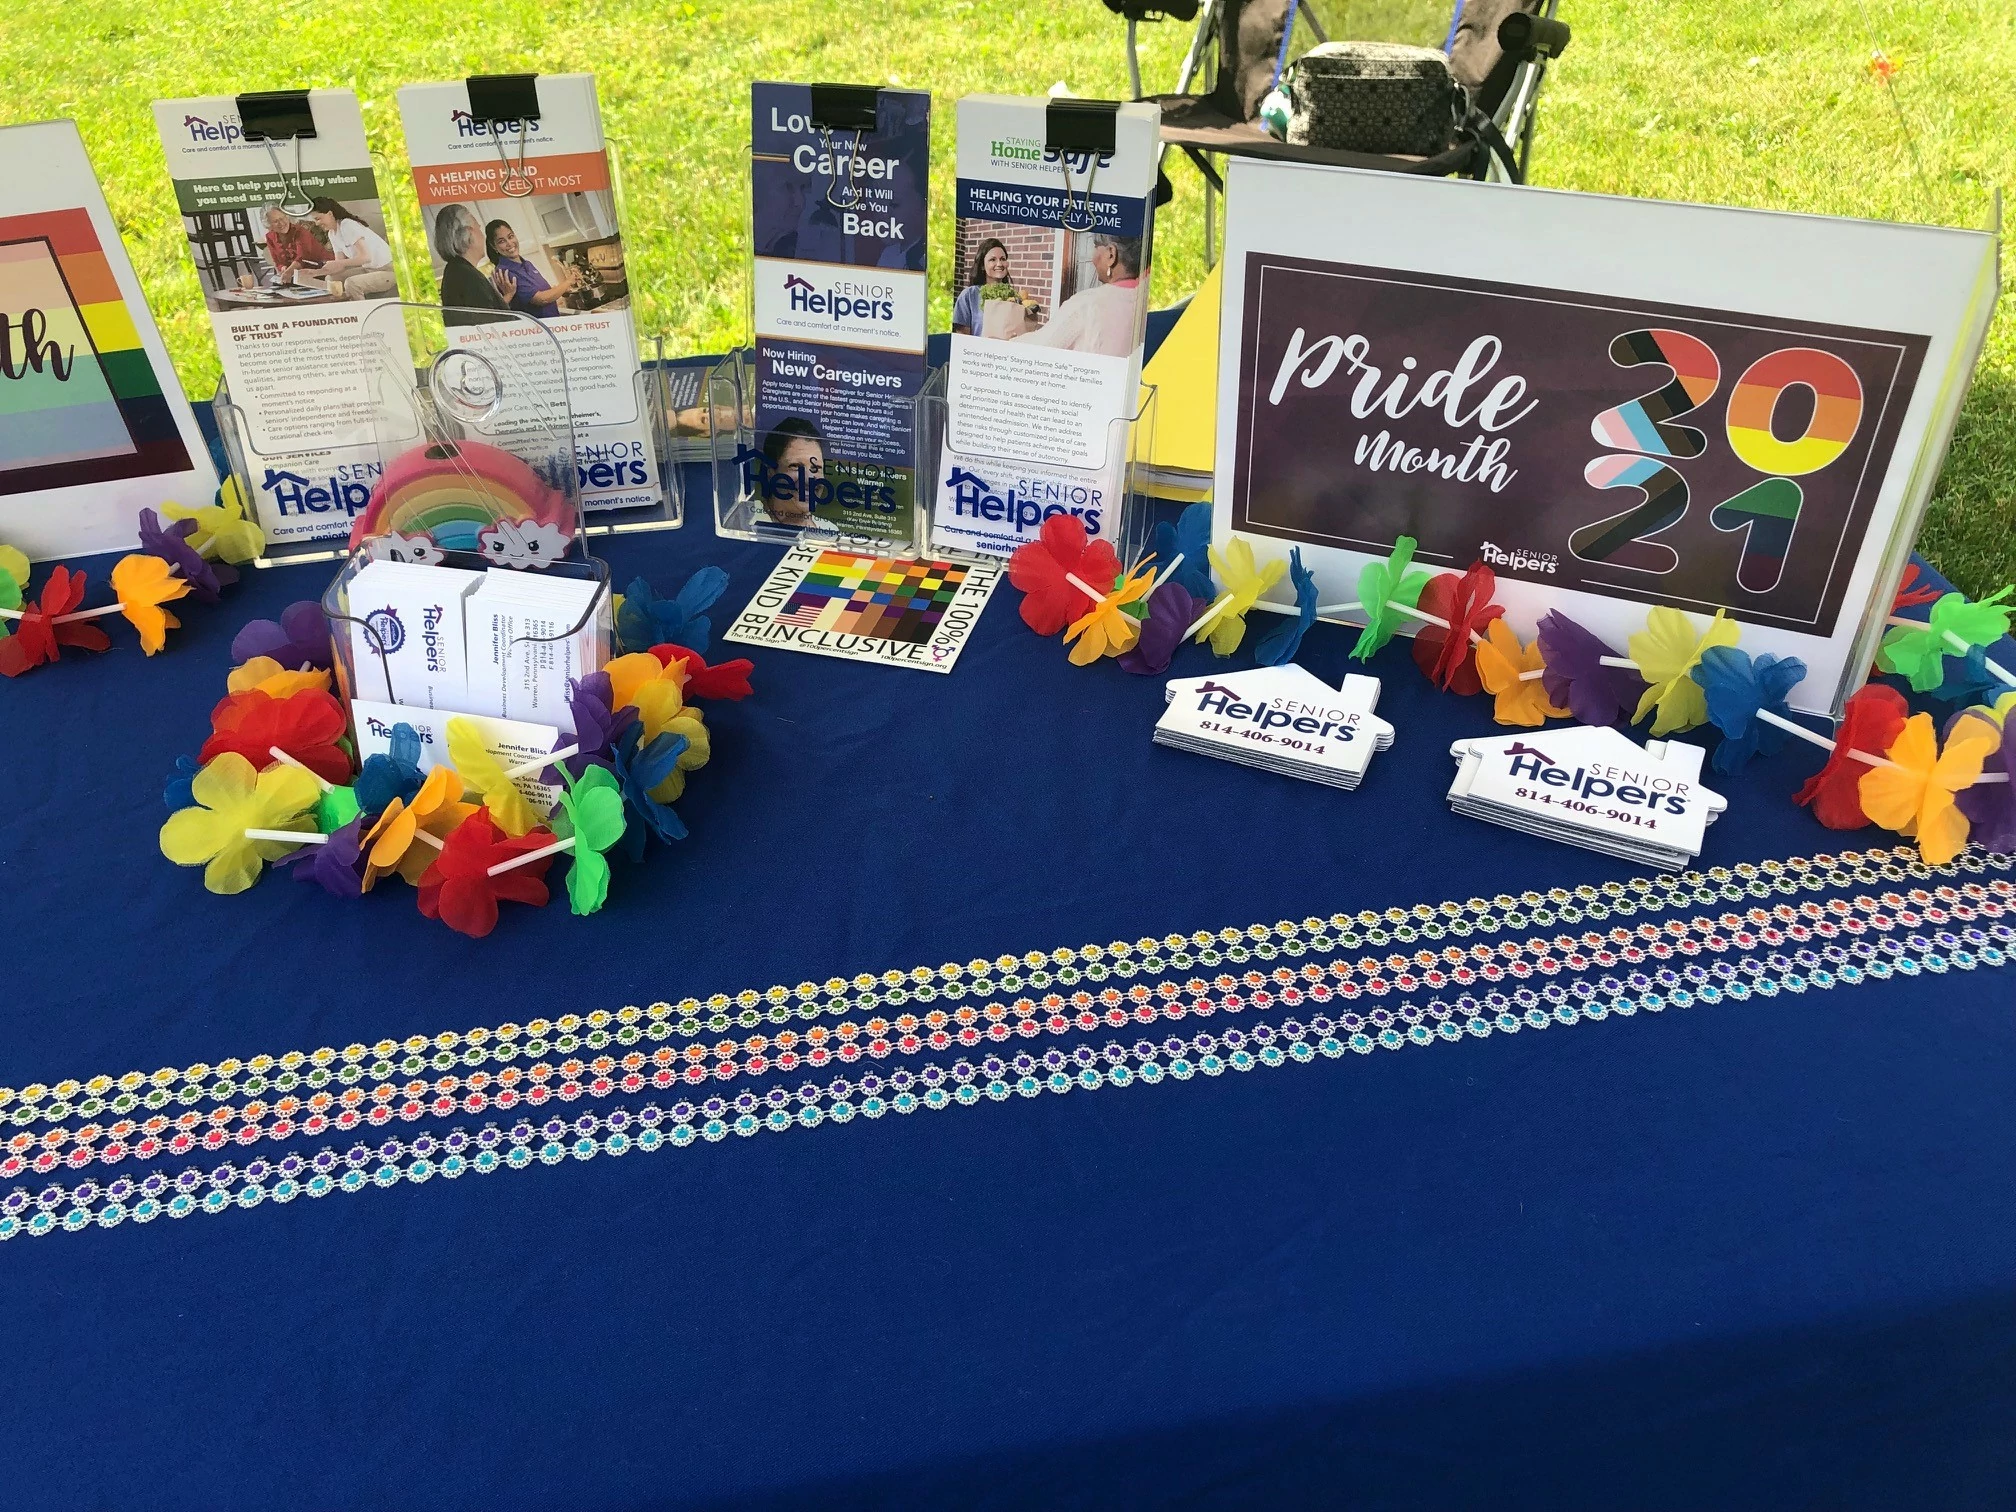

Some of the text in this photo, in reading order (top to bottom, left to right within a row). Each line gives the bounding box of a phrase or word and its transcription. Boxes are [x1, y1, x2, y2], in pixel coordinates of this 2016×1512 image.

[223, 115, 241, 123] SEN
[190, 121, 245, 143] Help
[1006, 137, 1041, 147] STAYING
[991, 140, 1041, 161] Home
[793, 145, 899, 180] Career
[991, 159, 1009, 168] WITH
[1011, 162, 1038, 171] SENIOR
[194, 184, 219, 194] Here
[222, 183, 234, 191] to
[237, 181, 261, 192] help
[291, 176, 325, 189] fmily
[328, 175, 357, 184] when
[428, 166, 538, 184] A HELPING HAND
[430, 183, 467, 197] WHEN
[470, 182, 496, 194] YOU
[535, 177, 546, 189] IT
[548, 175, 582, 187] MOST
[865, 188, 872, 198] It
[874, 189, 893, 200] Will
[197, 196, 217, 207] you
[220, 193, 246, 204] need
[249, 193, 263, 202] us
[868, 202, 888, 213] You
[970, 188, 1118, 214] HELPING YOUR PATIENTS
[970, 201, 1039, 219] TRANSITION
[843, 212, 904, 240] Back
[835, 281, 893, 299] SENIOR
[791, 287, 894, 321] Helpers
[231, 325, 260, 333] BUILT
[292, 316, 358, 328] FOUNDATION
[510, 325, 568, 337] FOUNDION
[570, 324, 583, 332] OF
[584, 321, 610, 330] TRUST
[794, 319, 806, 327] and
[808, 321, 832, 330] comfort
[847, 326, 878, 335] moment's
[233, 331, 283, 342] OF TRUST
[762, 347, 817, 364] Now Hiring
[963, 349, 982, 357] Senior
[1010, 356, 1032, 366] Staying
[1034, 360, 1053, 368] Home
[1073, 367, 1100, 375] program
[772, 359, 902, 388] New Caregivers
[1025, 369, 1050, 378] patients
[1080, 376, 1102, 385] families
[802, 384, 824, 392] become
[830, 387, 856, 396] Caregiver
[1590, 328, 1864, 476] 20
[338, 461, 382, 482] SEN
[274, 477, 374, 517] Help
[584, 496, 623, 506] moment's
[1018, 480, 1103, 507] SENIOR
[273, 521, 347, 536] Care and comfort
[1568, 454, 1804, 593] 21
[1484, 549, 1556, 573] Helpers
[1516, 549, 1558, 562] SENIOR
[756, 566, 800, 608] KIND
[961, 568, 999, 598] THE
[734, 612, 770, 635] BE
[934, 602, 979, 645] 100%
[422, 608, 439, 671] Helpers
[731, 631, 744, 639] The
[746, 634, 764, 642] 100%
[763, 624, 928, 660] INCLUSIVE
[437, 637, 446, 672] SENIOR
[799, 643, 858, 656] @100percentsign
[880, 655, 947, 669] 100percentsign.org
[1197, 693, 1357, 742] Helpers
[1271, 698, 1361, 726] SENIOR
[371, 724, 433, 744] Hers
[1199, 720, 1326, 755] 814-406-9014
[498, 743, 547, 755] Jennifer Bliss
[1509, 756, 1688, 815] Helpers
[1589, 763, 1689, 797] SENIOR
[1514, 787, 1657, 830] 814-406-9014
